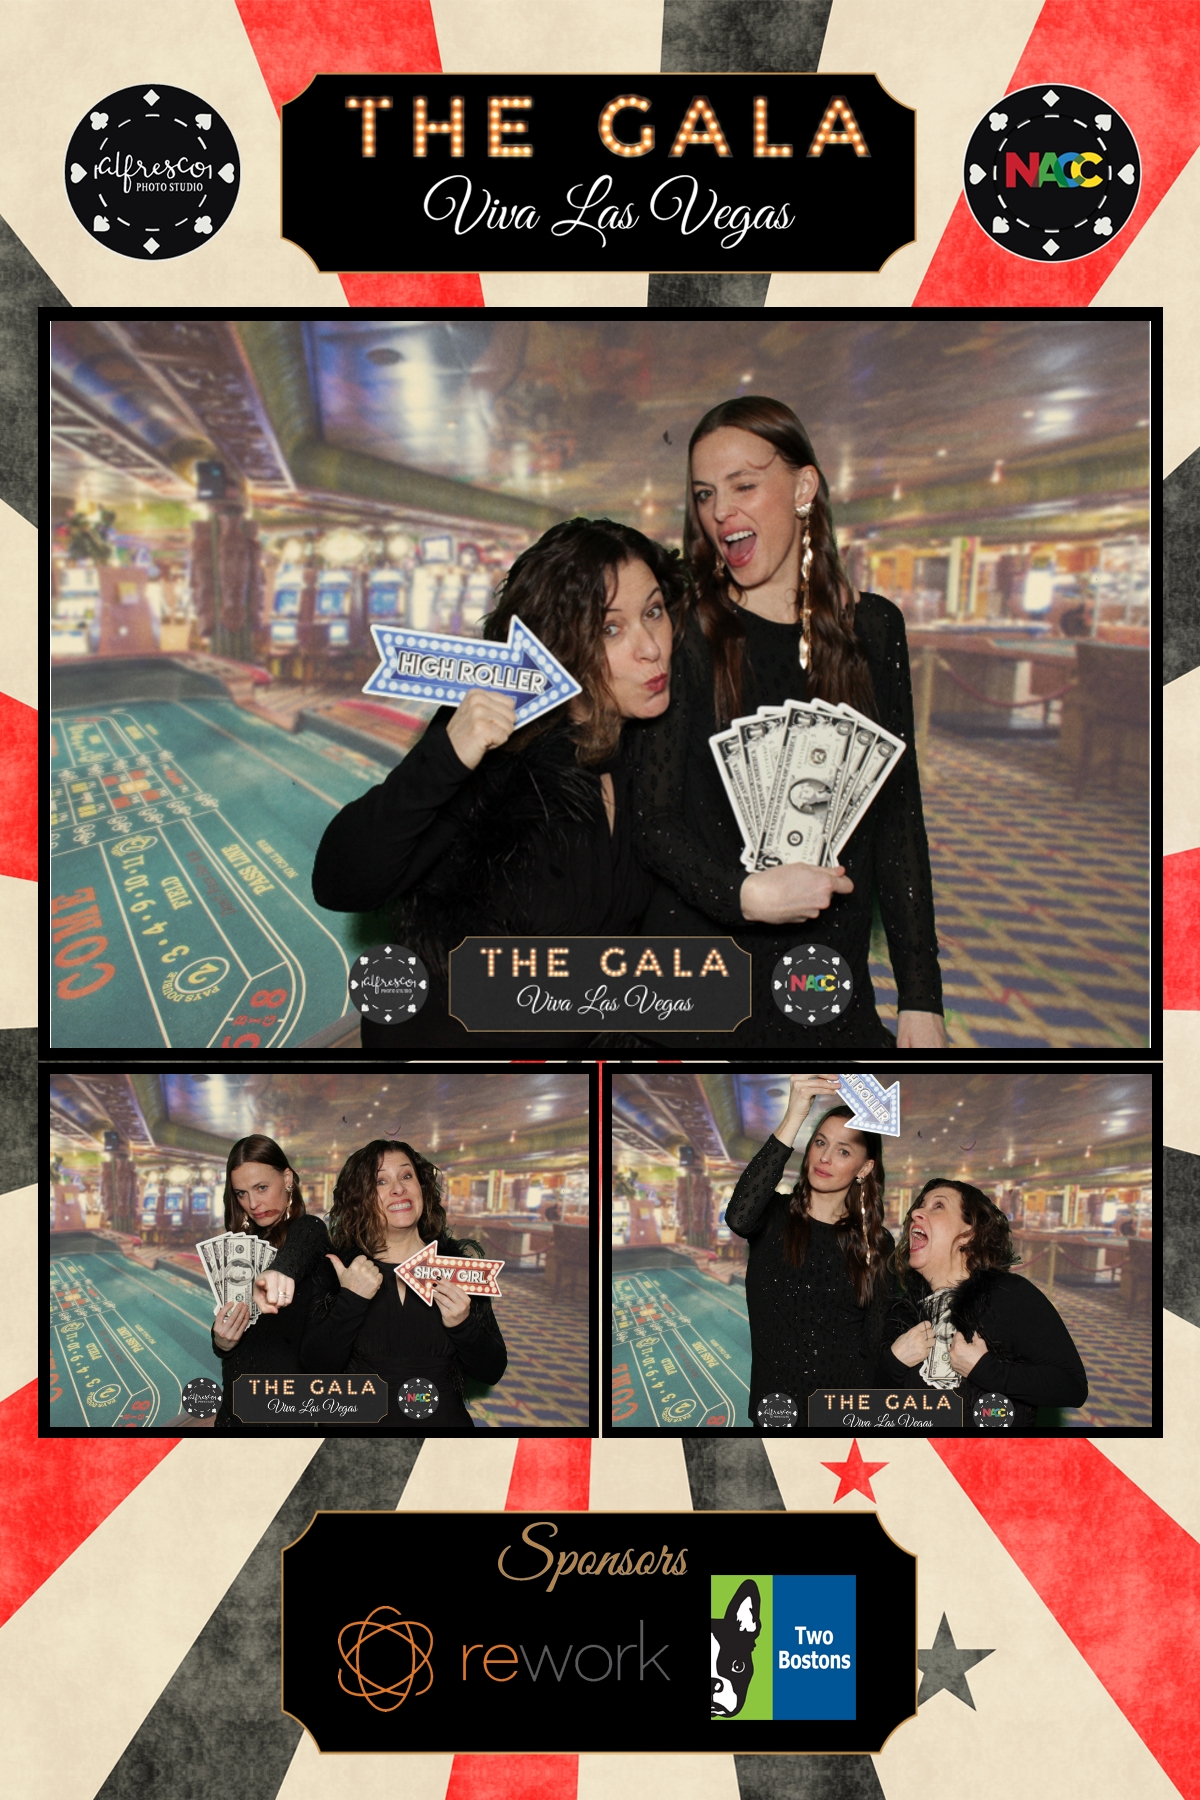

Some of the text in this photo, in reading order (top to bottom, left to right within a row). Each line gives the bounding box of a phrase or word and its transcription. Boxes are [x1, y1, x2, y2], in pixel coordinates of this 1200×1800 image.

[398, 652, 547, 694] HIGH ROLLER
[122, 854, 145, 870] 11
[221, 844, 275, 896] PASS LINE
[123, 874, 150, 893] 10
[161, 876, 193, 910] FIELD
[142, 921, 168, 935] 4
[51, 886, 116, 1000] COME
[161, 945, 190, 964] 3
[188, 963, 219, 984] 2
[185, 985, 221, 1002] PAYS
[250, 989, 288, 1009] 8
[853, 1081, 890, 1124] ROLLER
[413, 1266, 488, 1284] SHOW GIRL
